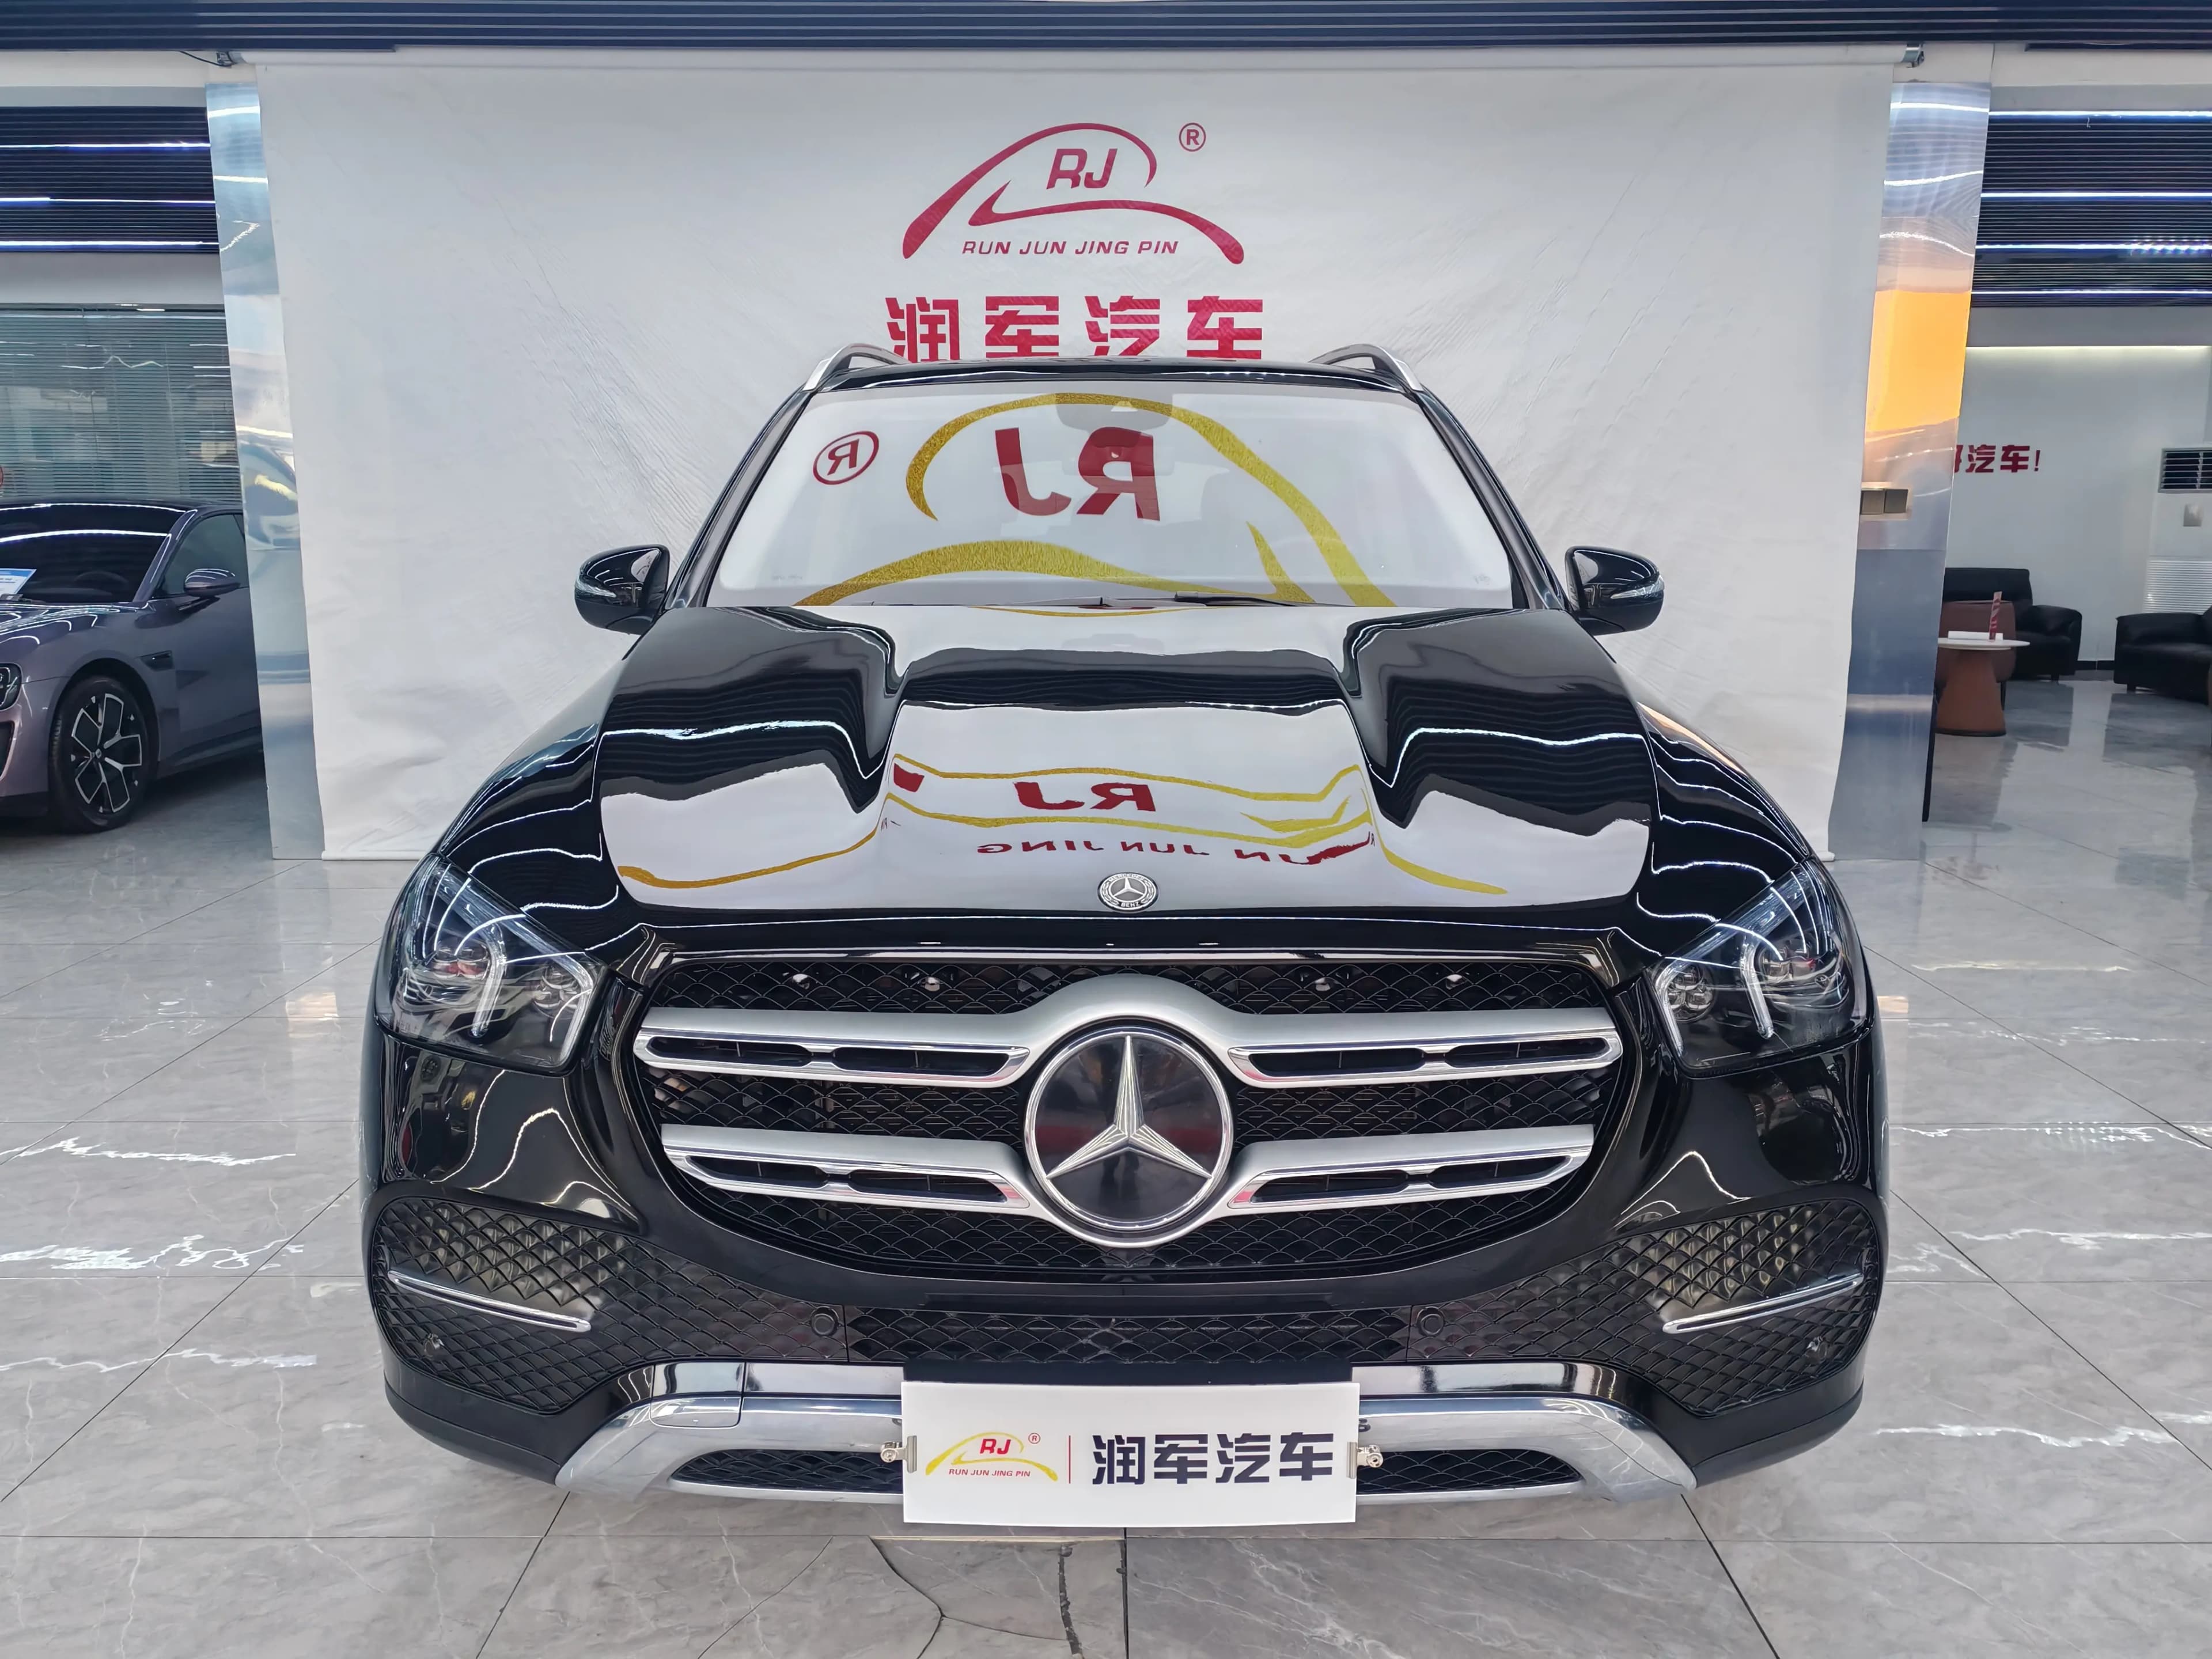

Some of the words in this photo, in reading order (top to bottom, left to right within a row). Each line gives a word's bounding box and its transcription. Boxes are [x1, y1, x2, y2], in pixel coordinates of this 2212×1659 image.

[1046, 148, 1118, 190] RJ
[962, 240, 1011, 255] RUN
[1018, 240, 1066, 255] JUN
[1074, 240, 1129, 255] JING
[1137, 240, 1179, 255] PIN
[885, 295, 1263, 362] 润军汽车
[979, 1438, 1012, 1455] RJ
[1092, 1431, 1334, 1484] 润军汽车
